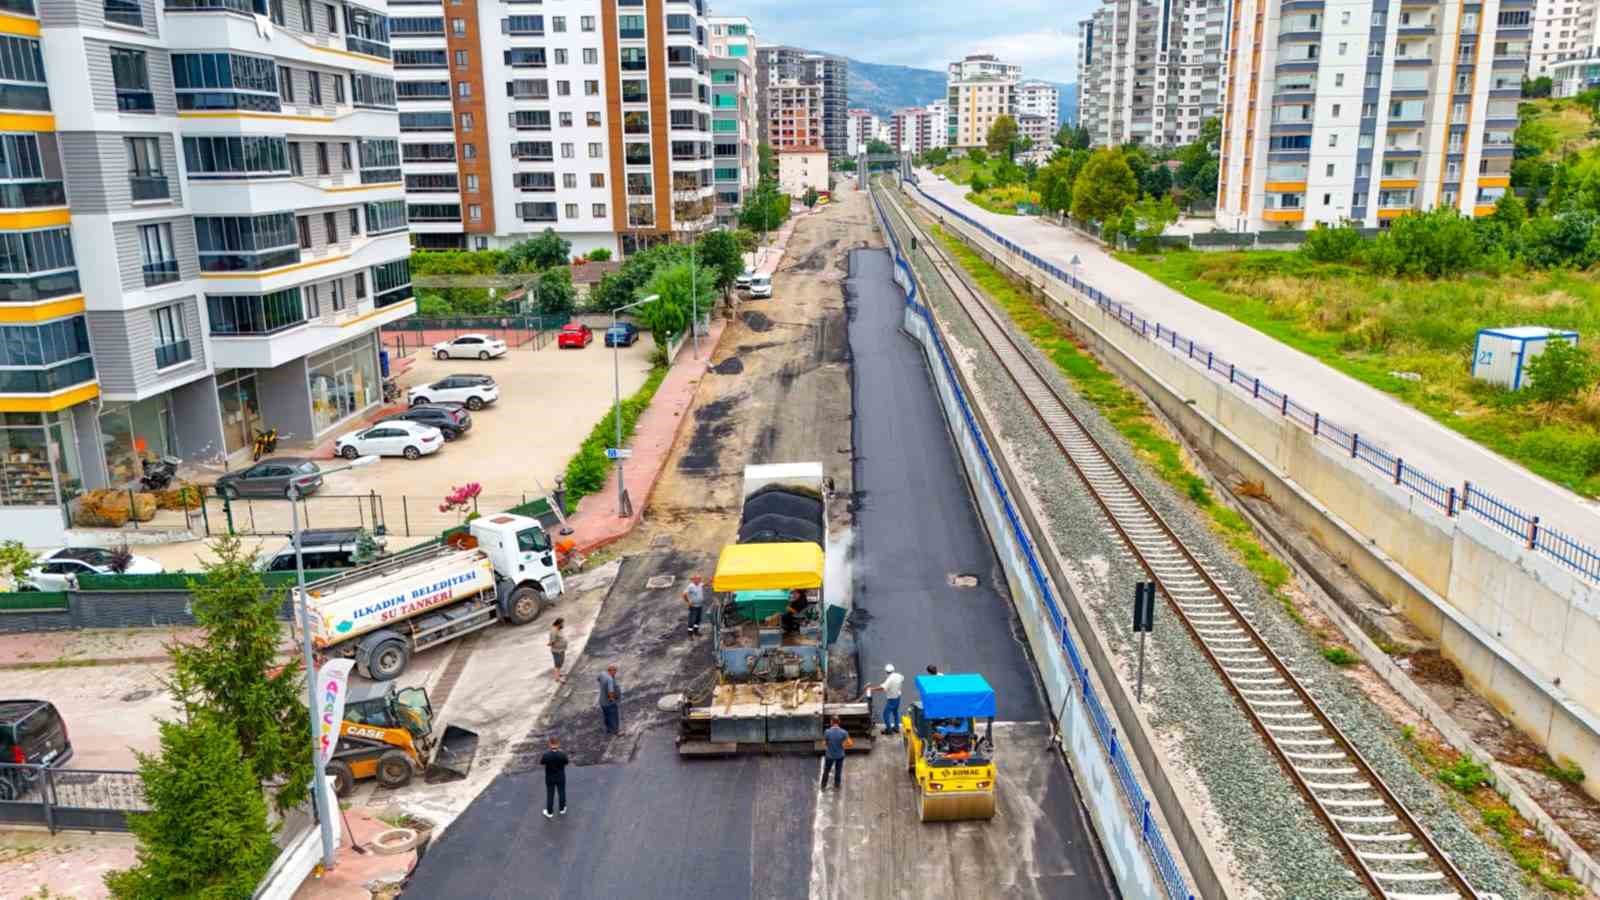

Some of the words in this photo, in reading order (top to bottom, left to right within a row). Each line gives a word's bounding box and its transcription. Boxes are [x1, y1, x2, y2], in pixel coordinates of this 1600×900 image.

[411, 570, 476, 599] BELEDİYESİ
[380, 610, 397, 622] SU
[399, 590, 453, 614] TANKERİ
[347, 726, 385, 739] CASE
